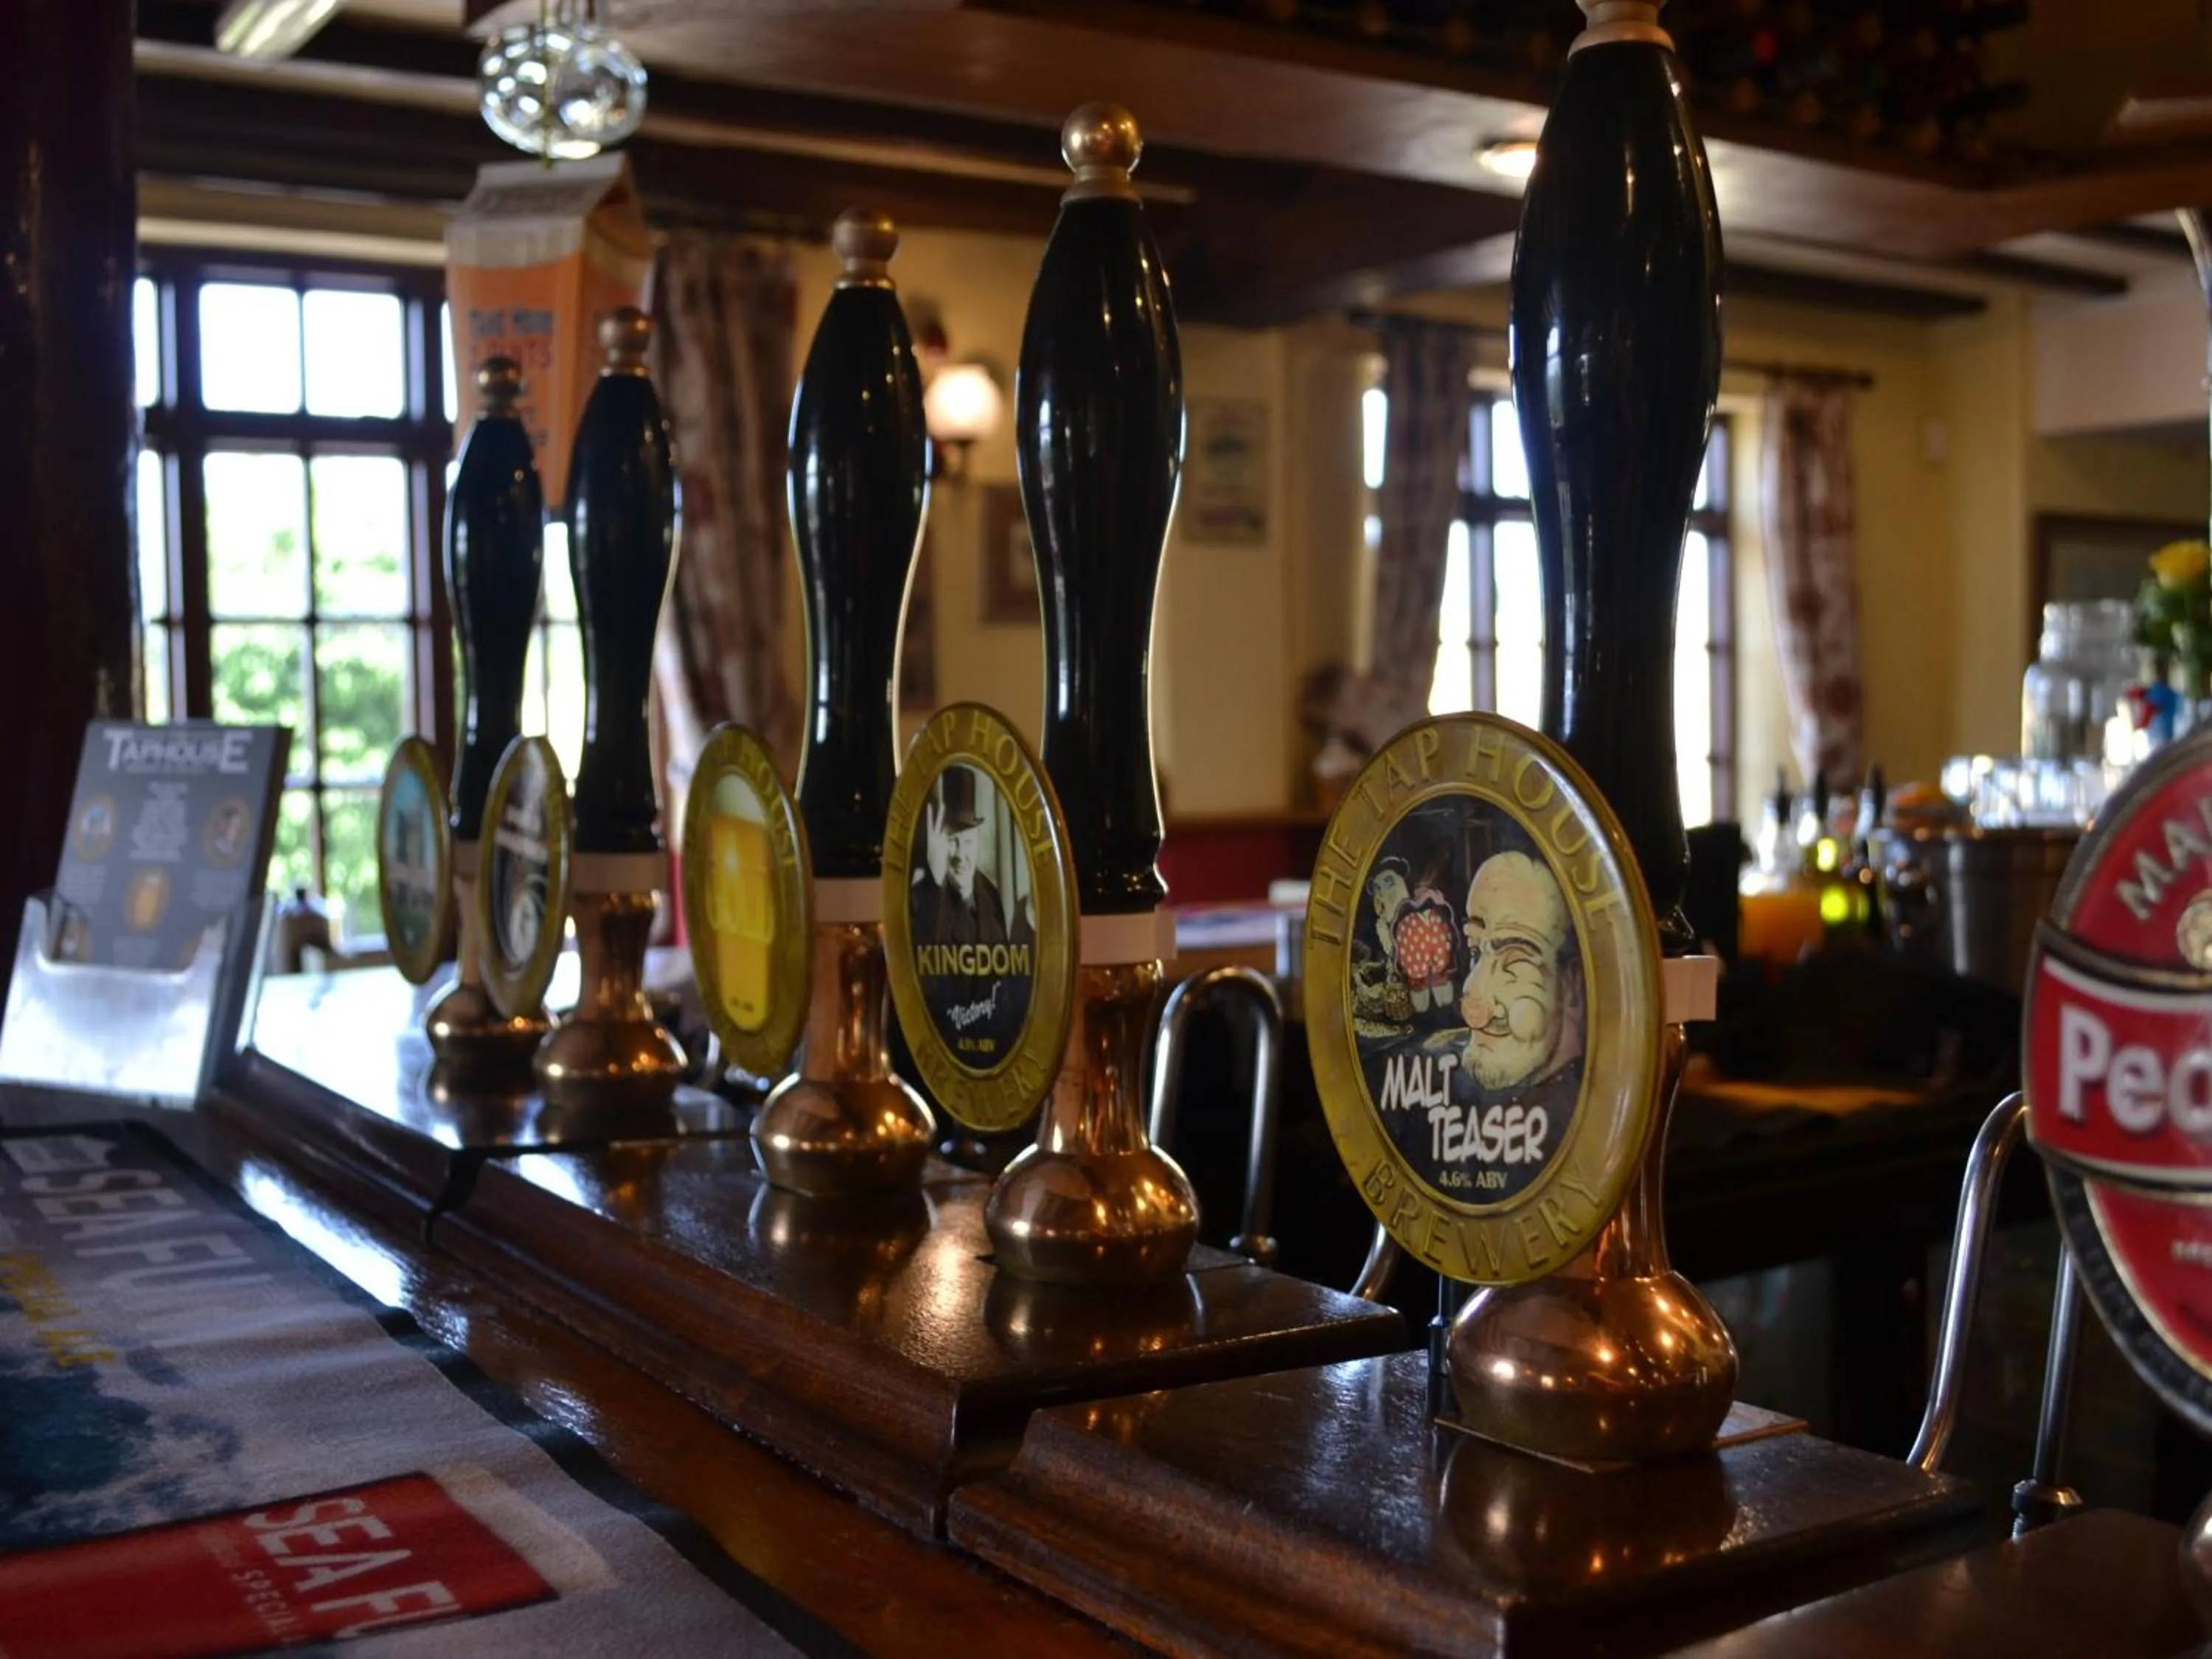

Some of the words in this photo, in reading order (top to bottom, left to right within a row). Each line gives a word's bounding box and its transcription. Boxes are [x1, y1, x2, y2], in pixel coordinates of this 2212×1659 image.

[970, 710, 1054, 868] HOUSE
[1311, 824, 1366, 947] THE
[1355, 726, 1441, 823] TAP
[1464, 723, 1622, 934] HOUSE
[917, 944, 1031, 976] KINGDOM
[1380, 1053, 1458, 1111] MALT
[1427, 1104, 1548, 1164] TEASER
[1439, 1171, 1472, 1189] 4.6%
[1475, 1171, 1508, 1189] ABV
[1363, 1155, 1604, 1278] BREWERY
